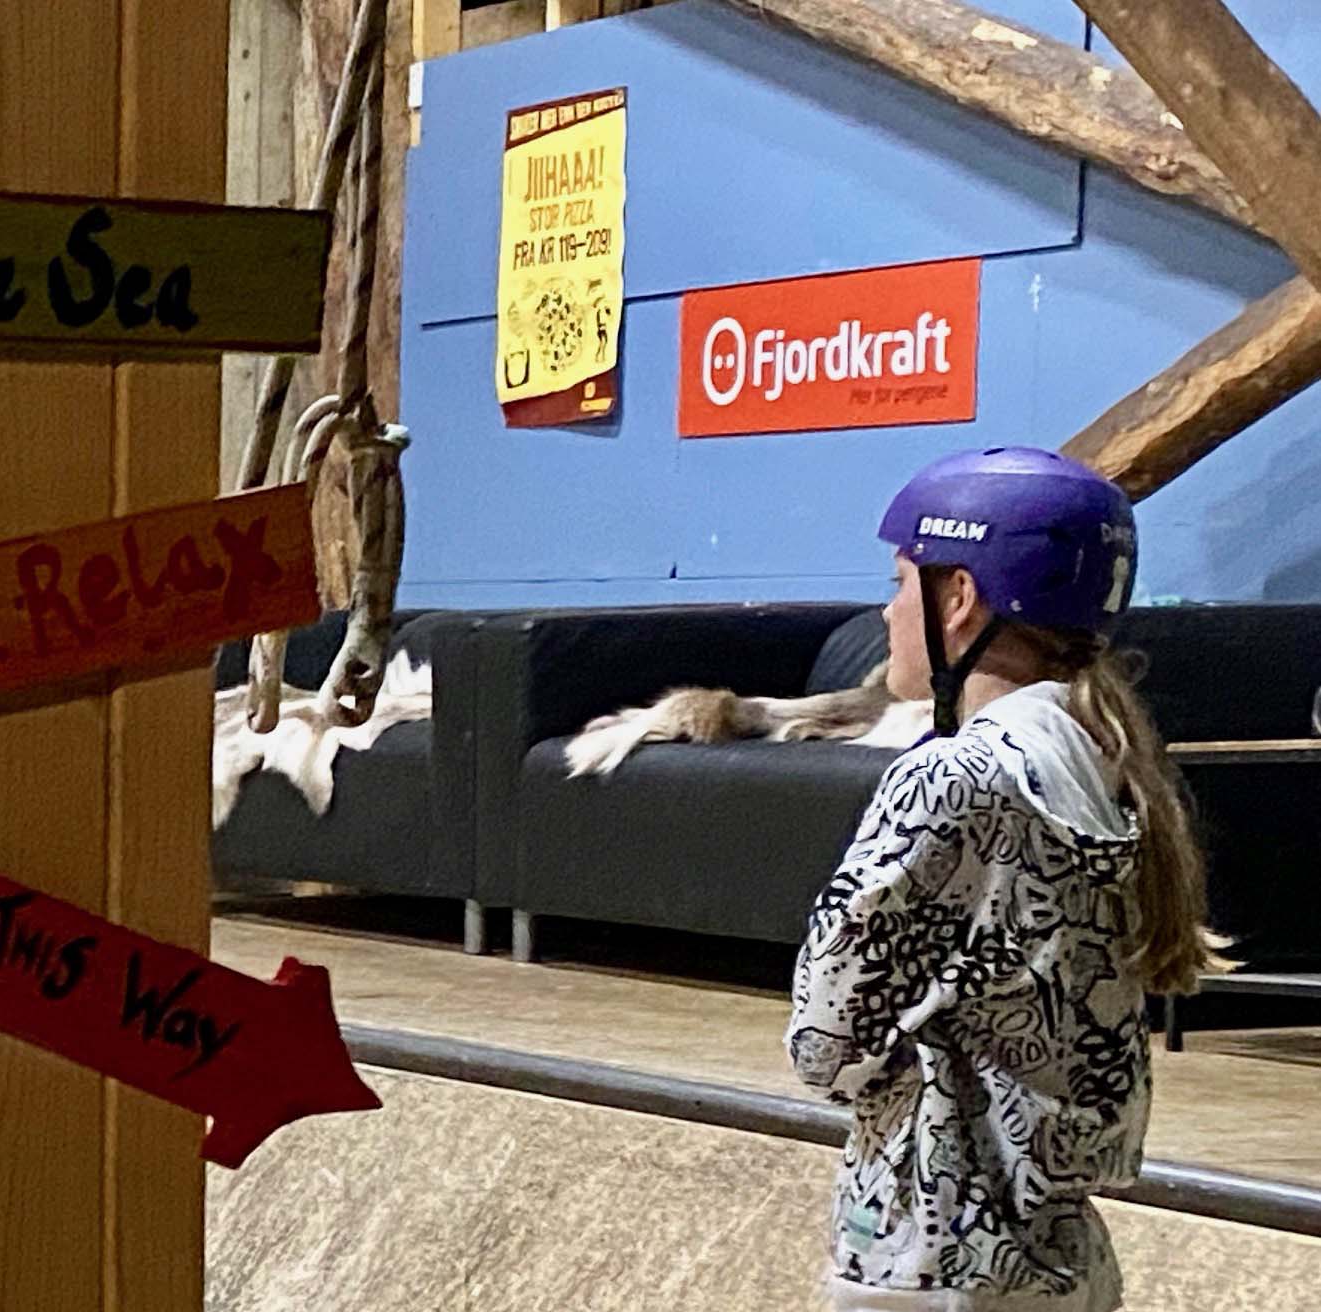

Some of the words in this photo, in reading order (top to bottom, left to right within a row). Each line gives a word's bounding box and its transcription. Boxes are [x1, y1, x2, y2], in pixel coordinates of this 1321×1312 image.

[47, 206, 199, 332] Sea
[752, 311, 952, 401] Fjordkraft
[14, 514, 283, 652] Relax
[919, 516, 989, 541] DREAM
[123, 946, 243, 1081] Way
